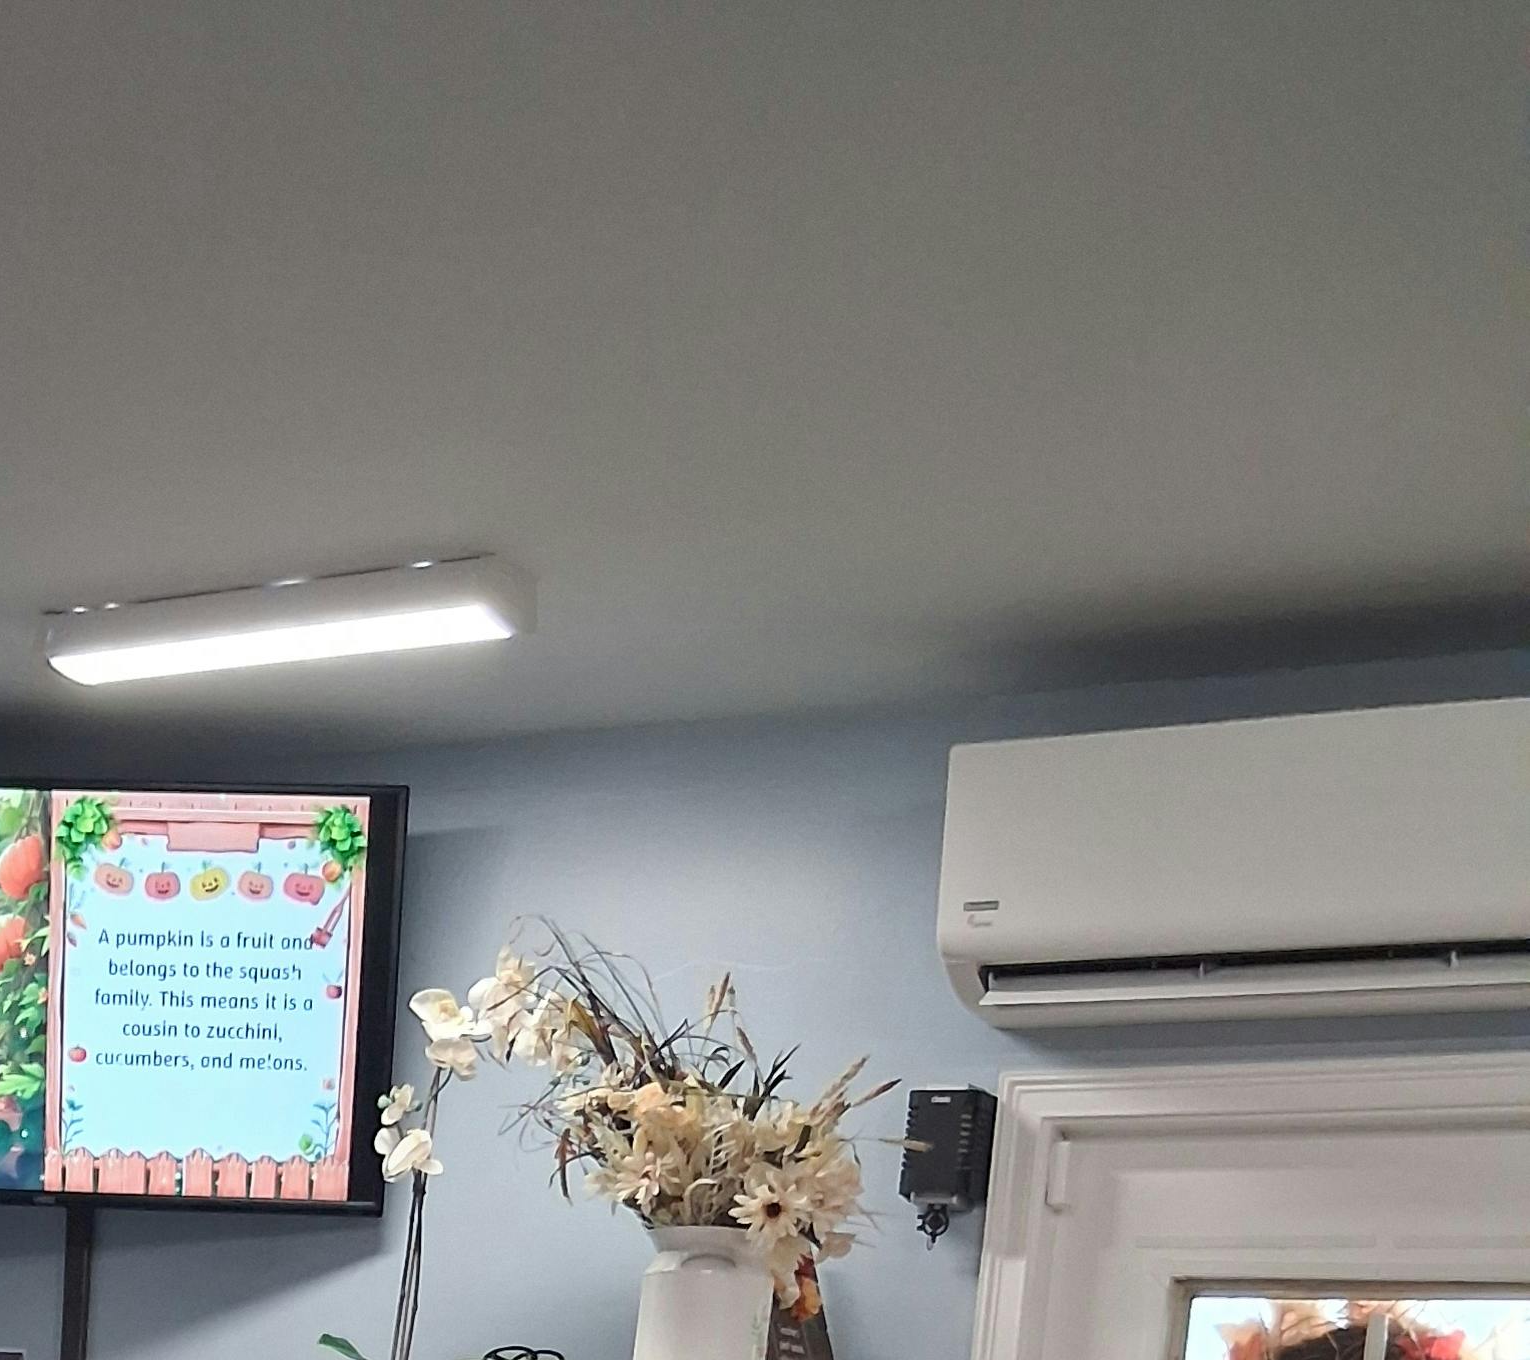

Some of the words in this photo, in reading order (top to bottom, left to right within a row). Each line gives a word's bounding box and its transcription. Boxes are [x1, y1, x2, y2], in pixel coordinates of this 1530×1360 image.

[98, 929, 110, 945] A
[116, 930, 194, 950] pumpkin
[200, 930, 214, 948] is
[220, 935, 230, 949] a
[237, 931, 274, 949] fruit
[281, 933, 314, 951] and
[108, 958, 177, 982] belongs
[183, 962, 200, 978] to
[206, 962, 233, 979] the
[239, 963, 302, 984] squash
[95, 988, 153, 1011] family.
[159, 990, 194, 1008] This
[200, 995, 259, 1010] means
[265, 992, 276, 1010] it
[284, 993, 297, 1011] is
[303, 998, 313, 1011] a
[122, 1020, 178, 1037] cousin
[184, 1022, 201, 1038] to
[206, 1022, 283, 1044] zucchini,
[95, 1050, 195, 1071] cucumbers,
[201, 1052, 233, 1069] and
[239, 1053, 308, 1072] melons.
